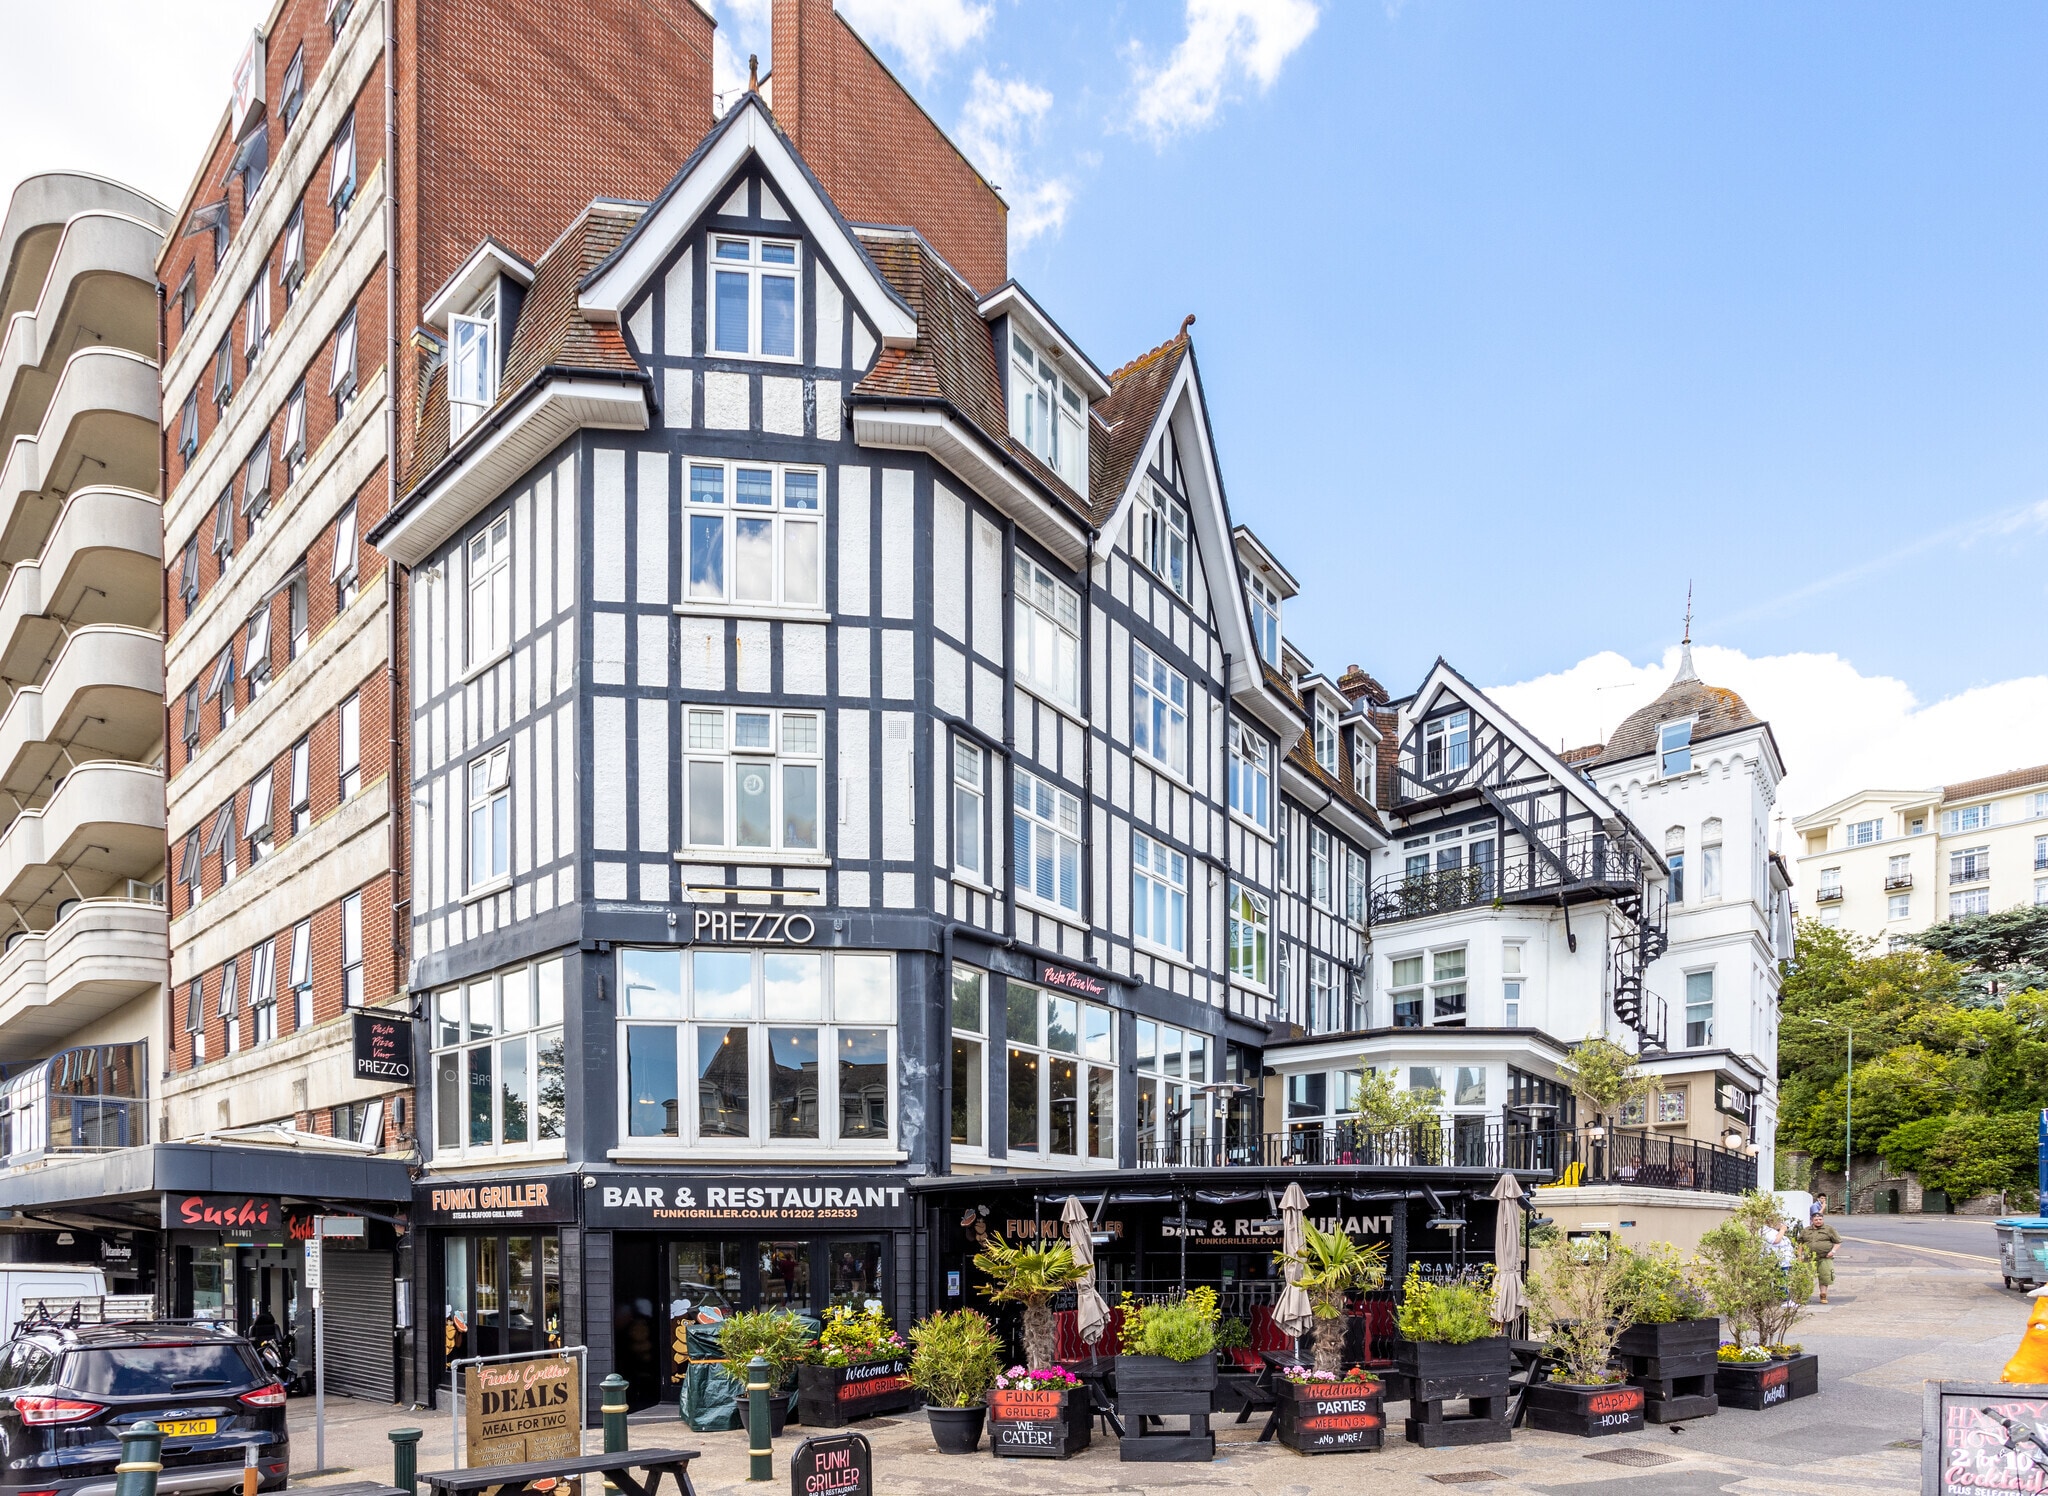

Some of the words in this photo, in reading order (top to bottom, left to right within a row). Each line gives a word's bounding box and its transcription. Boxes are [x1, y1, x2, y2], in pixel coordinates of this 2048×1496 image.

[695, 910, 815, 944] PREZZO
[371, 1023, 395, 1035] Pasta
[358, 1058, 409, 1077] PREZZO
[432, 1188, 476, 1211] FUNKI
[480, 1183, 549, 1208] GRILLER
[603, 1187, 664, 1208] BAR
[675, 1187, 697, 1207] &
[707, 1187, 905, 1208] RESTAURANT
[180, 1196, 269, 1226] Sushi
[653, 1209, 778, 1219] FUNKIGRILLER.CO.UK
[780, 1209, 814, 1219] 01202
[817, 1209, 858, 1218] 252533
[1211, 1219, 1227, 1236] &
[478, 1368, 519, 1389] Funki
[523, 1364, 569, 1390] Griller
[846, 1365, 890, 1380] Welcome
[894, 1361, 904, 1372] to
[843, 1382, 871, 1398] FUNKI
[1006, 1392, 1049, 1402] FUNKI
[1308, 1384, 1370, 1398] Weddings
[481, 1382, 568, 1415] DEALS
[1006, 1408, 1050, 1417] GRILLER
[1317, 1400, 1366, 1414] PARTIES
[179, 1421, 207, 1434] ZKO
[482, 1423, 513, 1436] MEAL
[517, 1418, 539, 1430] FOR
[542, 1414, 566, 1427] TWO
[1016, 1421, 1034, 1430] WE
[1315, 1417, 1365, 1428] MEETINGS
[1602, 1413, 1629, 1426] HOUR
[1003, 1431, 1052, 1444] CATER!
[1338, 1432, 1363, 1443] MORE!
[815, 1449, 850, 1472] FUNKI
[1951, 1449, 1972, 1467] 2
[1976, 1449, 2001, 1467] for
[806, 1468, 860, 1492] GRILLER
[1948, 1485, 1972, 1496] PLUS
